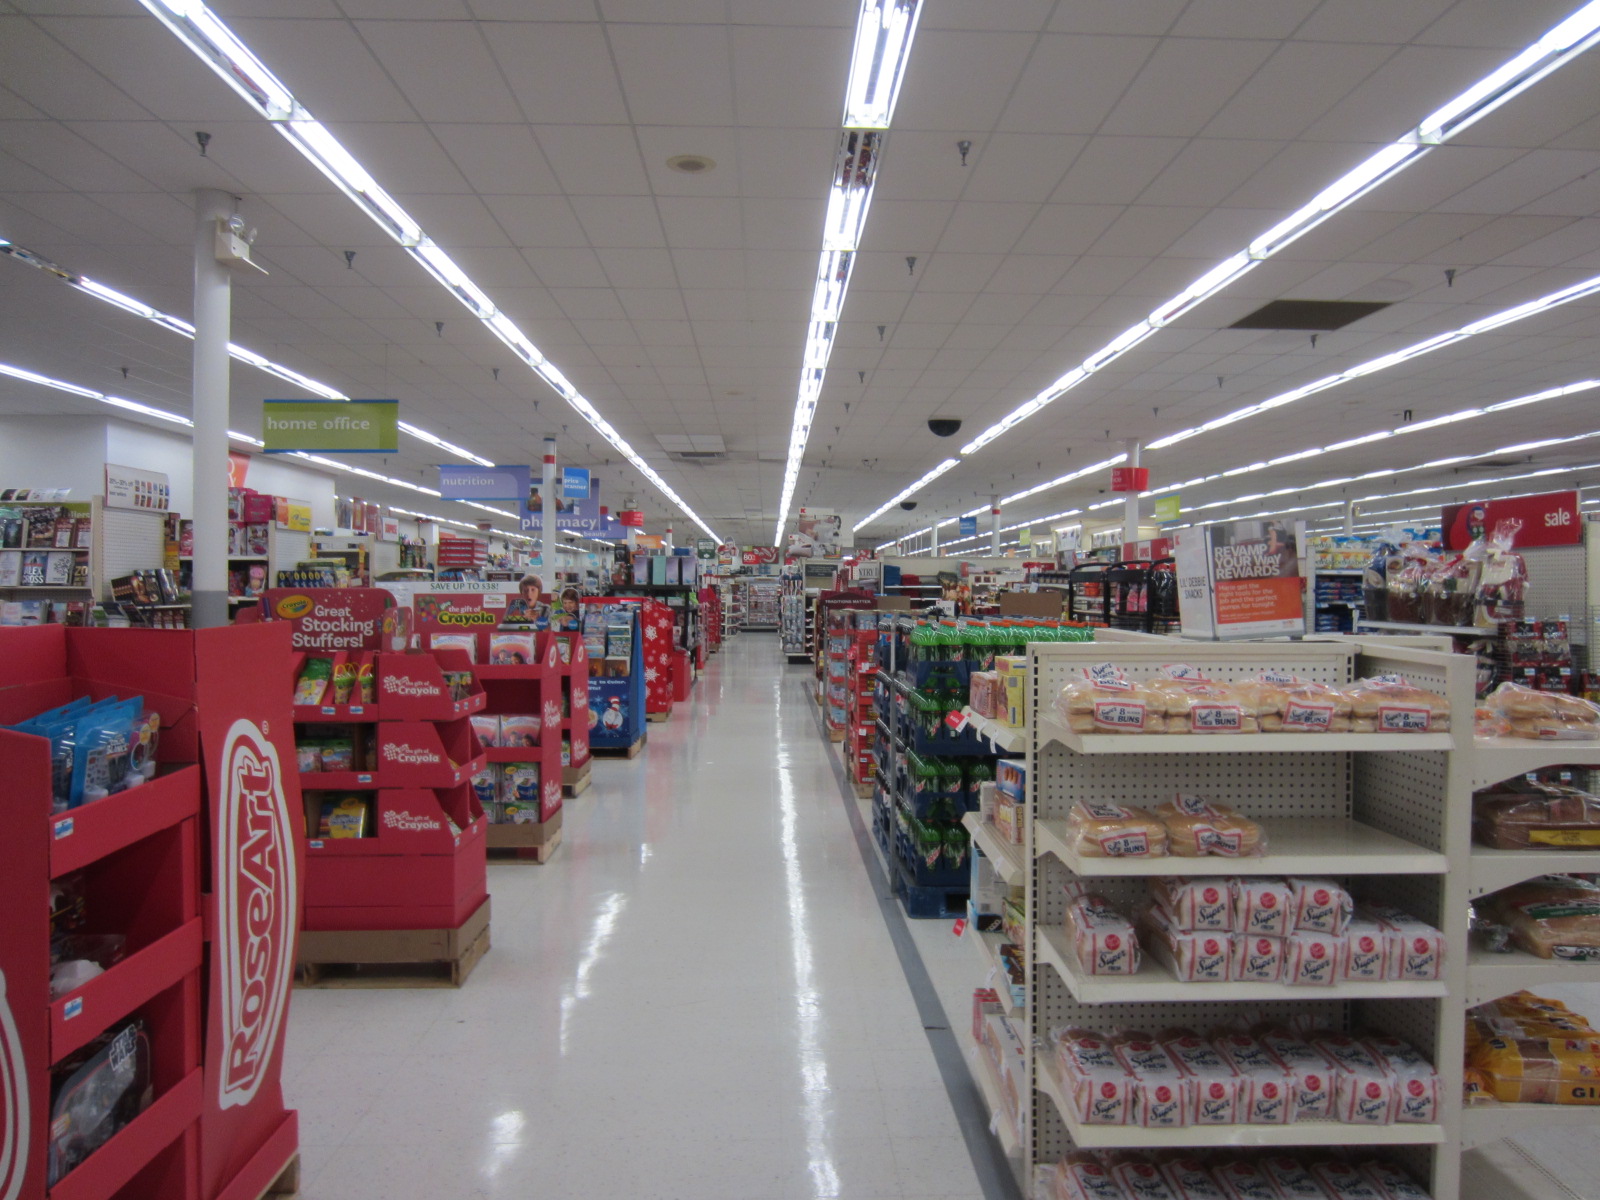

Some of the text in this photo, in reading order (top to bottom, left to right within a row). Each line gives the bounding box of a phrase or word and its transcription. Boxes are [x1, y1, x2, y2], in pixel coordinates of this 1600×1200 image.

[267, 416, 371, 431] home office
[442, 475, 495, 487] nutrition
[521, 515, 597, 531] phmacy
[1544, 508, 1571, 527] sale
[1214, 544, 1268, 559] REVAMP
[1215, 554, 1282, 569] YOUR WAY
[1216, 565, 1280, 580] REWARDS
[430, 583, 499, 591] SAVE UP TO $38!
[1185, 589, 1203, 600] SNACKS
[281, 599, 308, 610] Crayola
[315, 606, 351, 617] Great
[460, 605, 472, 615] gift
[474, 605, 481, 613] of
[302, 617, 374, 635] Stocking
[438, 611, 496, 627] Crayola
[292, 632, 364, 648] Stuffers!
[1091, 663, 1112, 677] Super
[398, 686, 440, 697] Crayola
[1117, 716, 1140, 724] BUNS
[1215, 718, 1237, 726] BUNS
[1304, 716, 1328, 724] BUNS
[1402, 720, 1426, 729] BUNS
[398, 753, 440, 765] Crayola
[398, 820, 440, 832] Crayola
[1123, 839, 1129, 847] 8
[1123, 845, 1146, 853] BUNS
[1197, 904, 1226, 923] Super
[1251, 908, 1281, 926] Super
[1303, 906, 1334, 922] Super
[226, 753, 275, 1092] RoseArt
[1098, 950, 1126, 968] Super
[1196, 955, 1225, 974] Super
[1246, 956, 1276, 973] Super
[1351, 953, 1380, 972] Super
[1405, 954, 1434, 973] Super
[1300, 959, 1330, 977] Super
[1130, 1053, 1166, 1069] Super
[1181, 1049, 1216, 1063] Super
[1297, 1091, 1326, 1108] Super
[1571, 1087, 1600, 1098] GI
[1092, 1099, 1121, 1117] Super
[1150, 1101, 1178, 1121] Super
[1202, 1099, 1231, 1118] Super
[1253, 1099, 1283, 1117] Super
[1355, 1100, 1386, 1116] Super
[1403, 1097, 1432, 1114] Super
